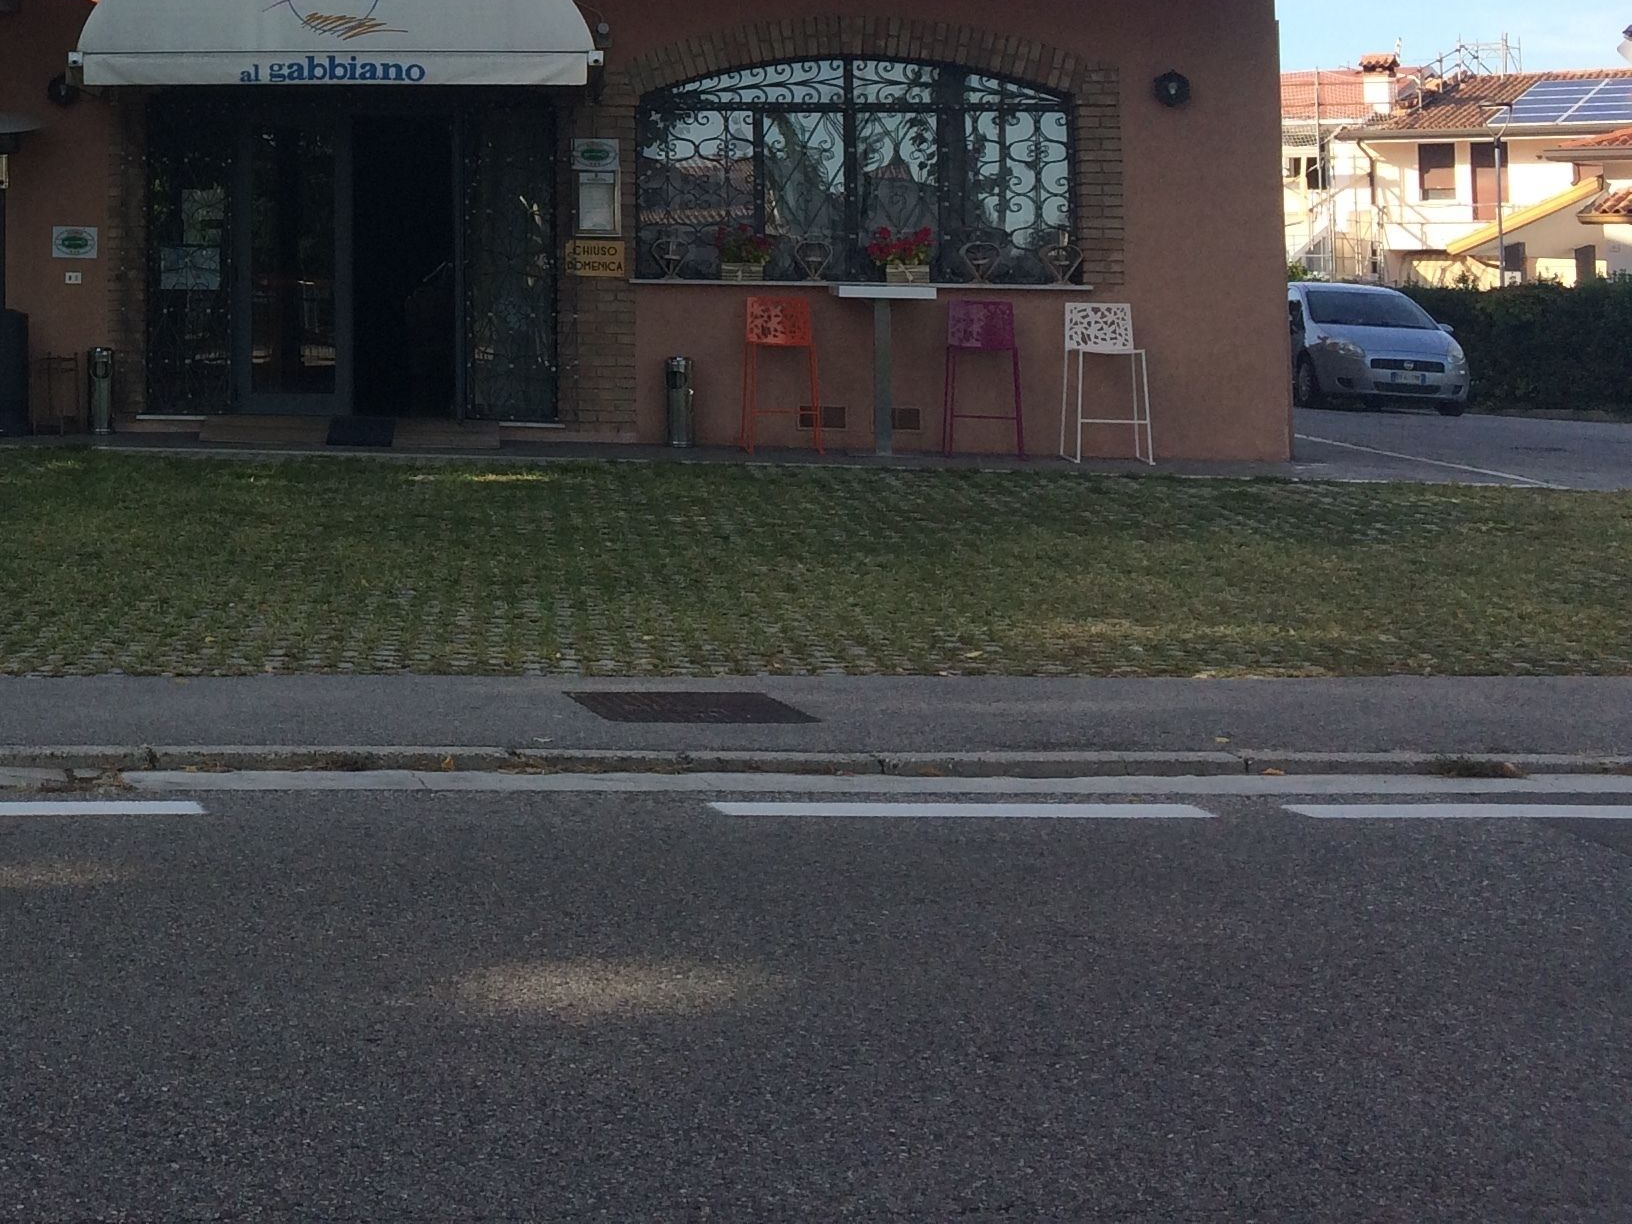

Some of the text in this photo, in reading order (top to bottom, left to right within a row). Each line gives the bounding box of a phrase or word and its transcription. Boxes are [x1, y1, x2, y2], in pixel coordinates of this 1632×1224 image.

[240, 55, 426, 83] al gabbiano
[573, 245, 618, 257] CHIUSO
[567, 260, 623, 272] DOMENICA
